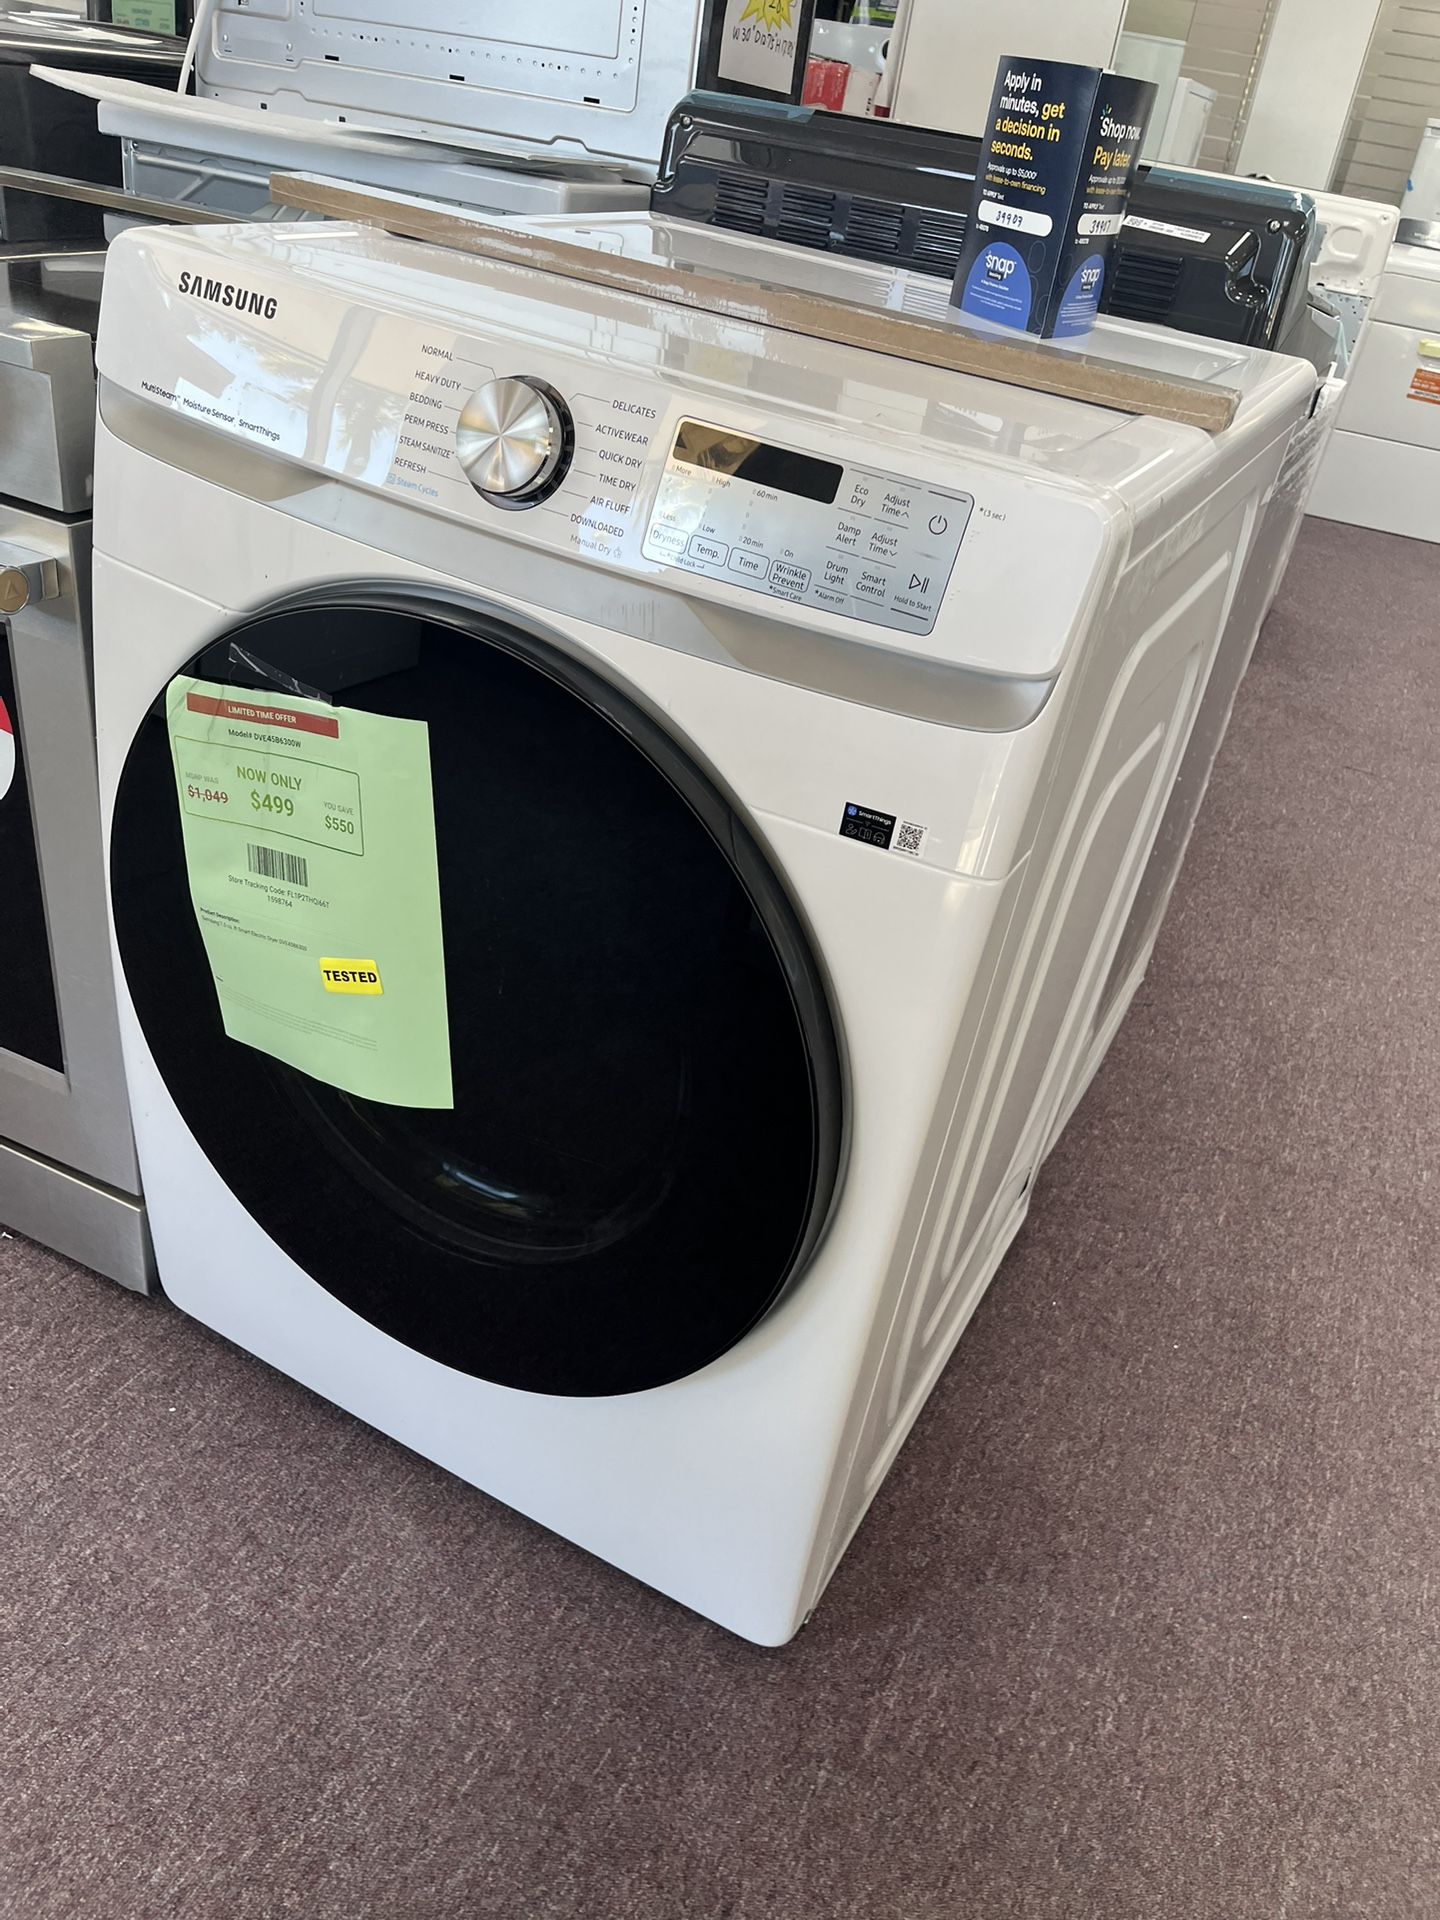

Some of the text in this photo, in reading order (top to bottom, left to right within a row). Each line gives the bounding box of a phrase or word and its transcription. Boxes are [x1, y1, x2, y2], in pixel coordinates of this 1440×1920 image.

[1004, 70, 1042, 93] Apply in
[1000, 94, 1066, 120] minutes, get
[995, 117, 1060, 142] a decision in
[1100, 117, 1126, 144] Shop
[990, 140, 1033, 161] seconds.
[1093, 145, 1113, 171] Pay
[178, 271, 278, 320] SAMSUNG
[421, 344, 454, 361] NORMAL
[414, 369, 462, 391] HEAVY DUTY
[409, 391, 442, 409] BEDDING
[612, 399, 657, 420] DELICATES
[182, 396, 212, 415] Moisture
[238, 418, 280, 442] SmartThings
[404, 413, 449, 435] PERM PRESS
[399, 435, 422, 450] STEAM
[595, 424, 649, 446] ACTIVEWEAR
[394, 456, 427, 474] REFRESH
[598, 449, 643, 470] QUICK DRY
[675, 465, 693, 476] More
[396, 477, 439, 498] Steam Cycles
[599, 473, 637, 493] TIME DRY
[715, 477, 731, 489] High
[854, 484, 869, 496] Eco
[756, 489, 778, 501] 60 min
[850, 494, 866, 508] Dry
[884, 493, 910, 508] Adjust
[590, 495, 631, 515] AIR FLUFF
[881, 503, 901, 518] Time
[570, 513, 624, 539] DOWNLOADED
[702, 523, 716, 534] Low
[837, 521, 861, 538] Damp
[570, 534, 612, 557] Manual Dry
[652, 528, 685, 547] Dryness
[742, 536, 764, 549] 20 min
[835, 533, 857, 547] Alert
[871, 532, 898, 547] Adjust
[696, 543, 720, 560] Temp.
[784, 549, 794, 558] On
[868, 542, 889, 557] Time
[738, 556, 759, 571] Time
[776, 563, 807, 582] Wrinkle
[826, 560, 848, 575] Drum
[772, 573, 805, 591] Prevent
[824, 571, 845, 585] Light
[861, 571, 886, 587] Smart
[787, 591, 802, 601] Care
[856, 582, 886, 598] Control
[834, 595, 845, 605] Off
[894, 594, 932, 612] Hold to Start
[228, 705, 297, 724] LIMITED TIME OFFER
[237, 765, 302, 791] NOW ONLY
[187, 784, 229, 804] $1,049
[250, 789, 294, 817] $499
[323, 801, 355, 816] YOU SAVE
[325, 815, 355, 835] $550
[228, 874, 243, 884] Store
[244, 879, 268, 893] Tracking
[323, 969, 378, 984] TESTED
